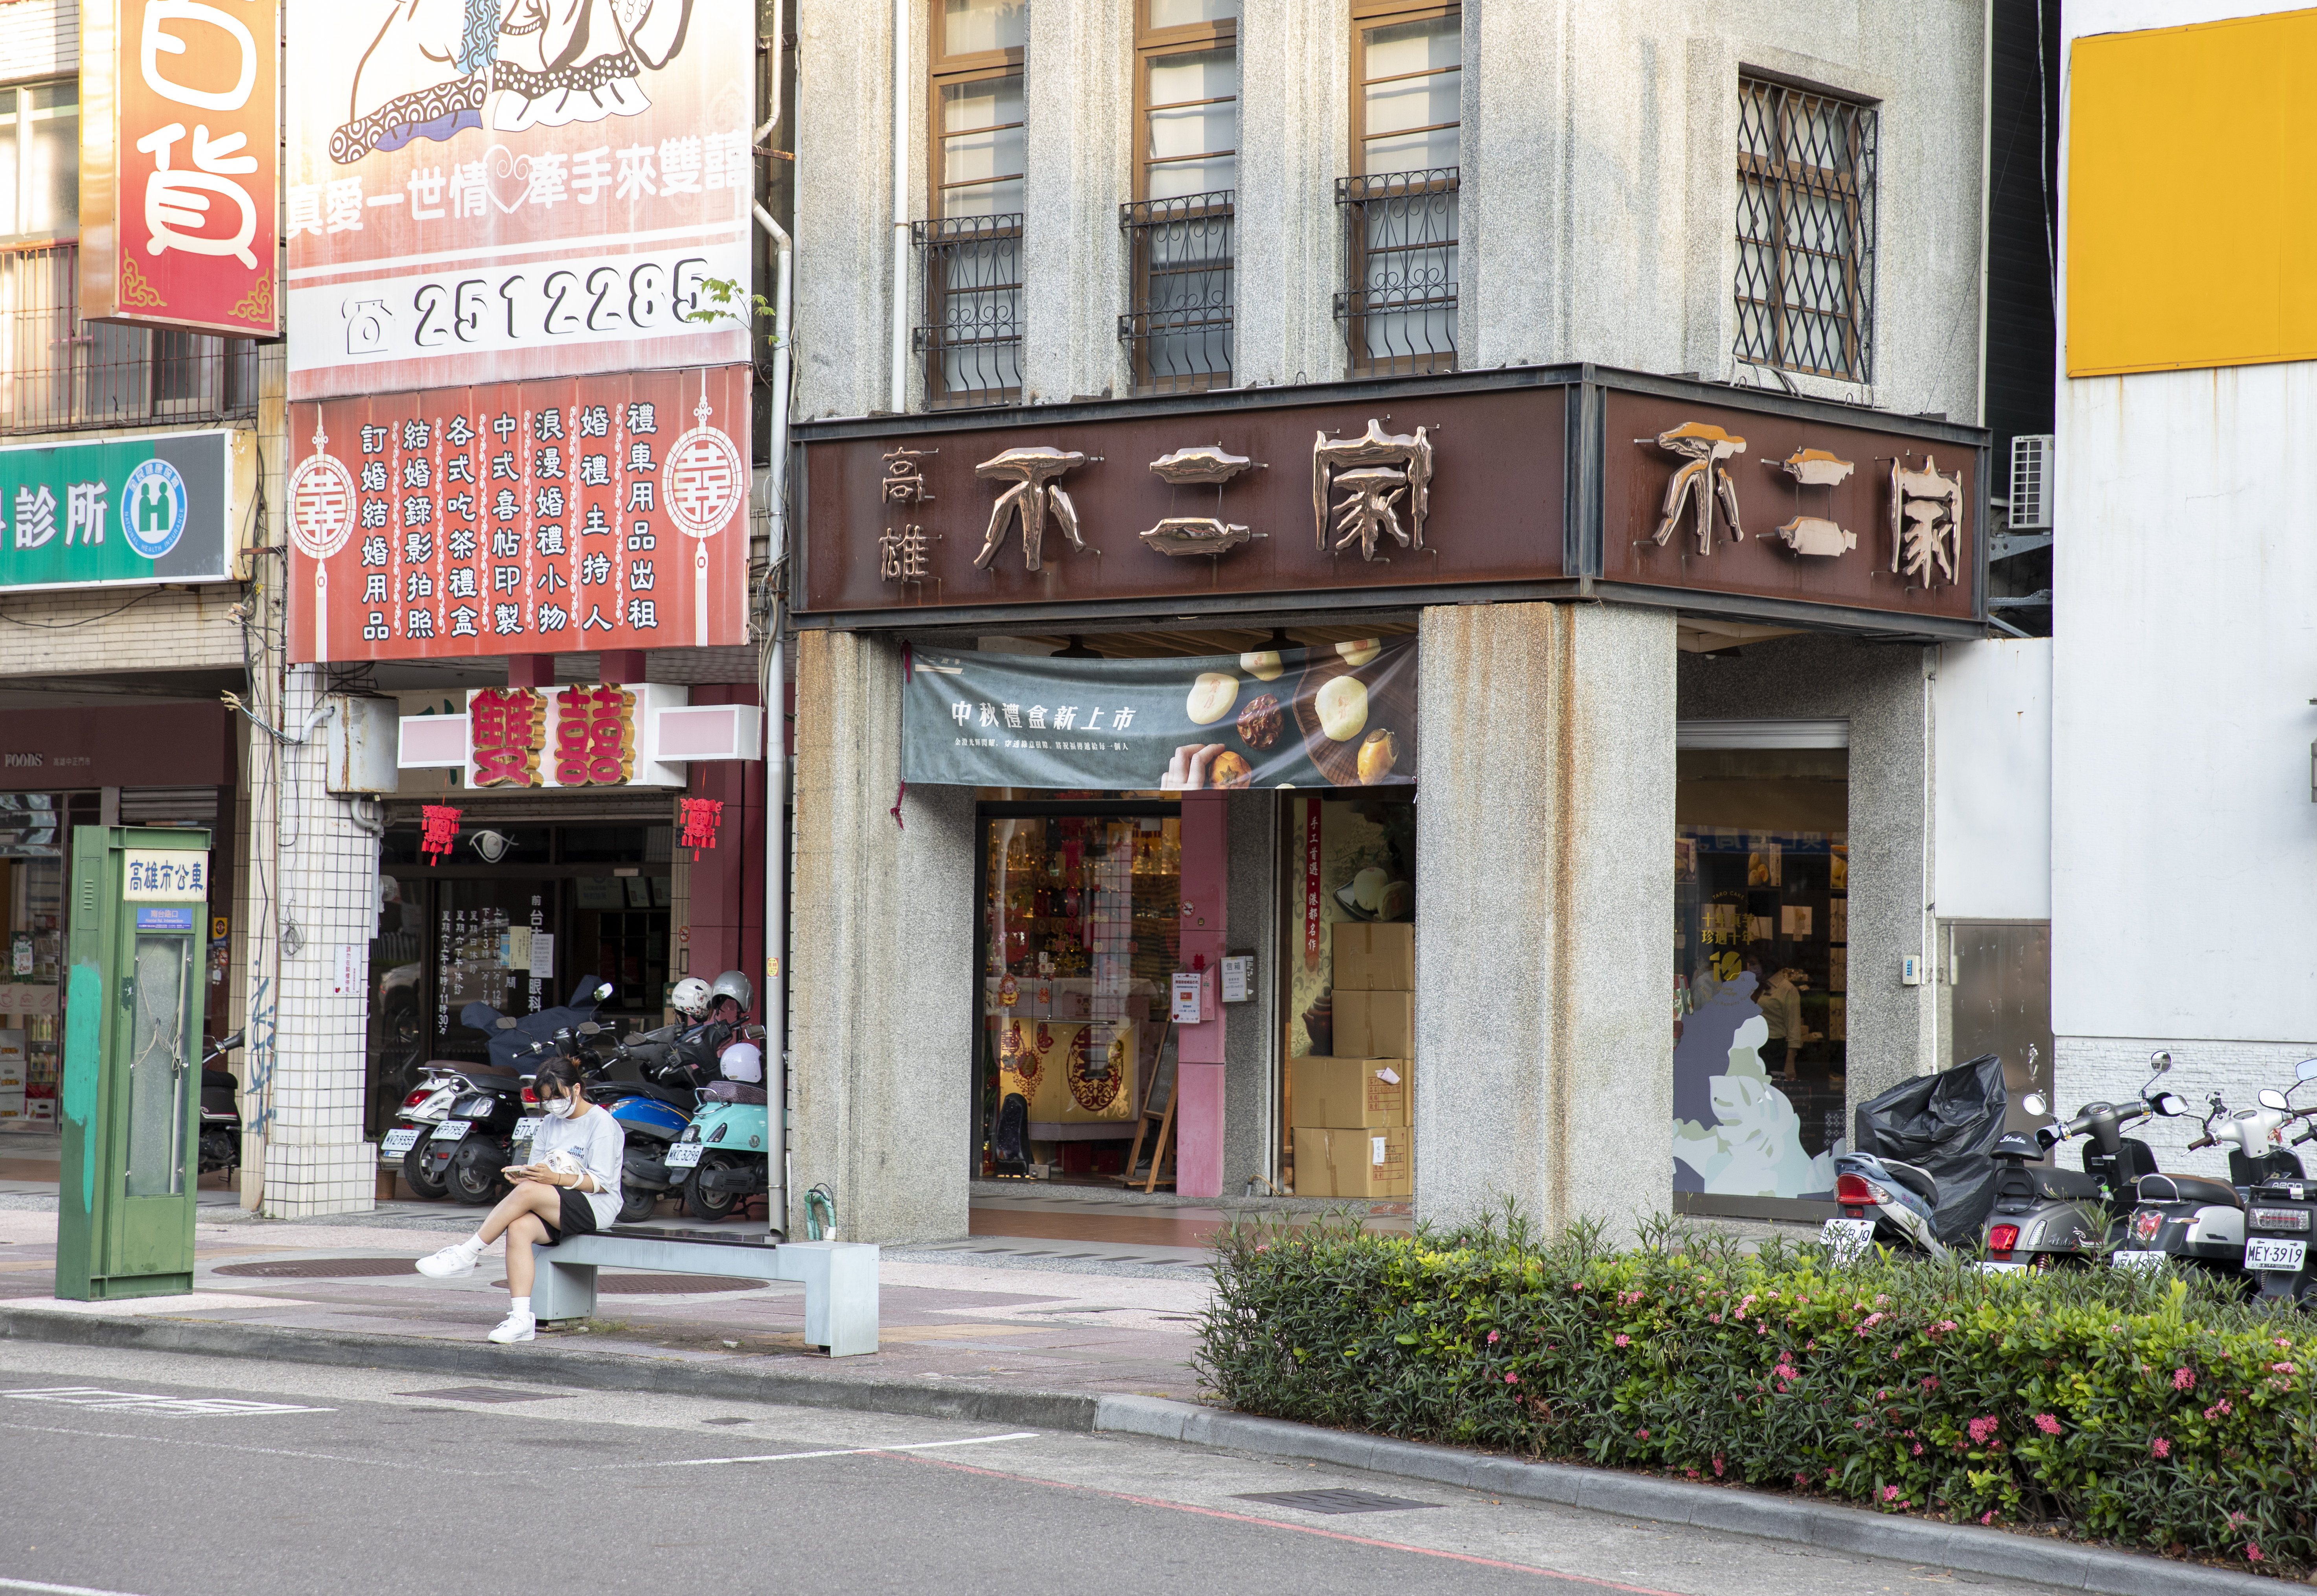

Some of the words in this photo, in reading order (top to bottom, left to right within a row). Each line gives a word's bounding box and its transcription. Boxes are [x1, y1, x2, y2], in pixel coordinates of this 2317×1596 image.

[287, 162, 488, 239] 真愛一世情
[528, 129, 747, 210] 牽手來雙囍
[415, 258, 708, 346] 2512285
[0, 478, 109, 550] 診所
[124, 511, 139, 546] NATIONAL
[141, 544, 162, 553] HEALTH
[164, 508, 184, 547] INSURANCE
[129, 464, 180, 492] 全民健康保險
[403, 418, 435, 639] 結婚錄影拍照
[446, 414, 478, 638] 各式吃茶禮盒
[491, 411, 524, 637] 中式喜帖印製
[535, 407, 567, 633] 浪漫婚禮小物
[580, 404, 613, 631] 婚禮主持人
[626, 401, 659, 630] 禮車用品出租
[879, 446, 929, 582] 高雄
[974, 419, 1434, 570] 不二家
[1652, 422, 1964, 589] 不二家
[360, 424, 389, 641] 訂婚結婚用品
[5, 753, 43, 767] FOODS
[53, 757, 90, 766] 高雄中正門市
[470, 682, 631, 787] 雙囍
[951, 701, 1136, 731] 中秋禮盒新上市
[130, 860, 203, 893] 高雄市公車
[151, 909, 178, 918] 南台路口
[1713, 891, 1727, 900] TARO
[1730, 891, 1745, 900] CAKE
[2247, 1246, 2303, 1263] MEY-3919
